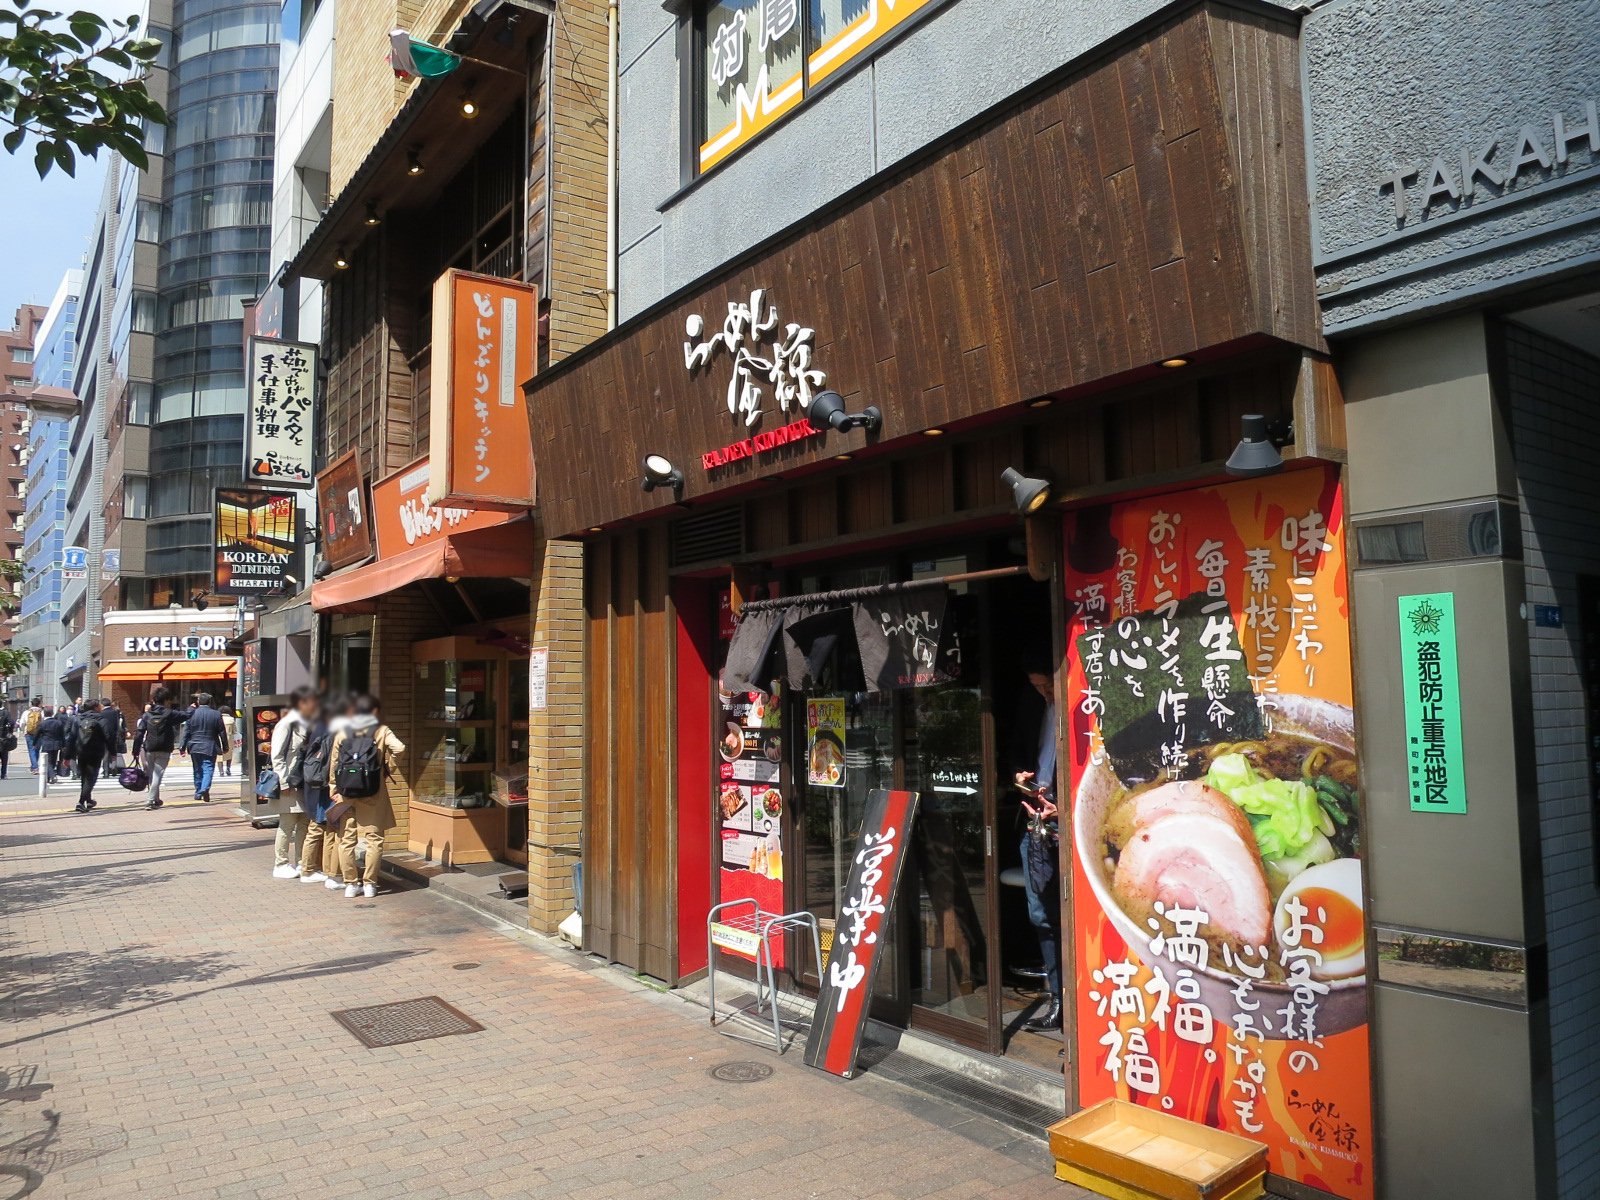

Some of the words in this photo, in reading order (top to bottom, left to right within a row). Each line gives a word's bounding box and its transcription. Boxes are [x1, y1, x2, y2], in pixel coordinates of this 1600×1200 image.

[1378, 99, 1600, 219] TAKAH
[255, 354, 281, 438] 手仕事料理
[223, 551, 289, 564] KOREAN
[231, 564, 281, 575] DINING
[1110, 546, 1152, 698] お客様の心を
[1281, 508, 1333, 688] 味にこだわり
[124, 635, 227, 652] EXCELSOR
[1073, 584, 1115, 772] 満たす店でありたい。
[932, 770, 979, 783] いらっしゃいませ
[1416, 640, 1449, 804] 盗犯防止重点地区
[830, 826, 896, 1013] 営業中
[1145, 901, 1217, 1064] 満福。
[1275, 896, 1331, 1074] お客様の
[1088, 958, 1175, 1110] 満福。
[1222, 941, 1274, 1134] 心もおなかも
[1287, 1089, 1340, 1119] らーめん
